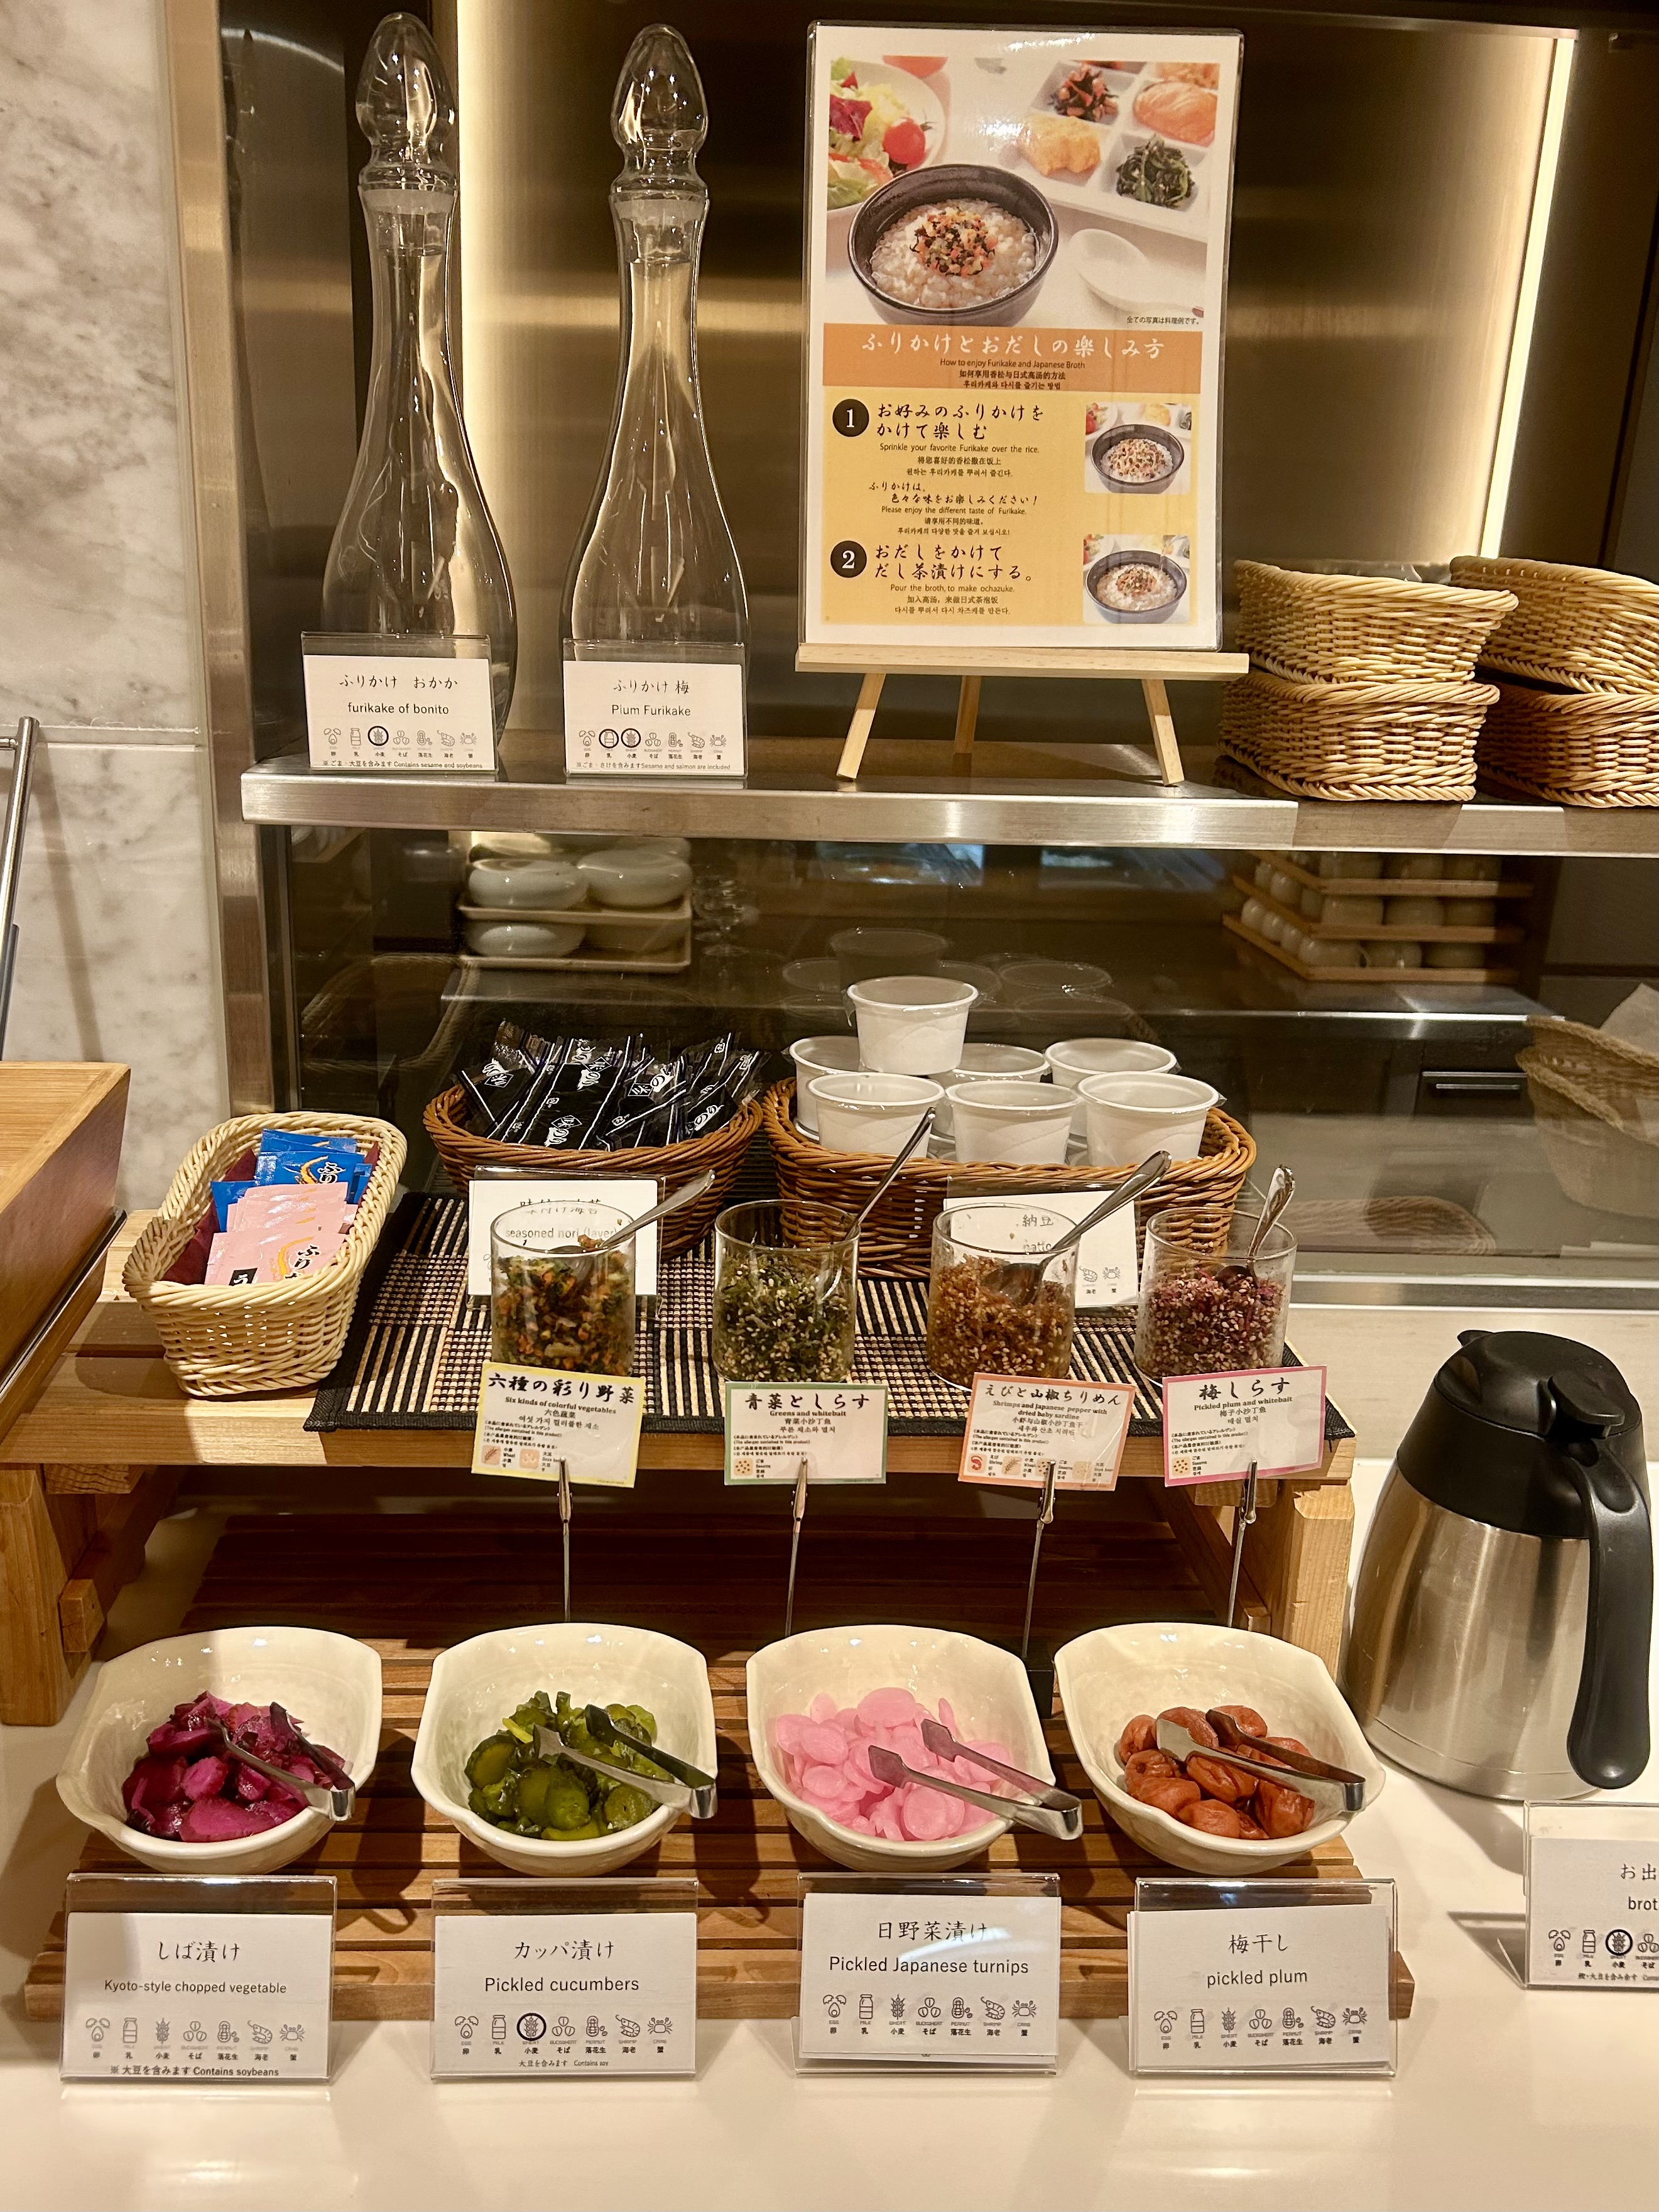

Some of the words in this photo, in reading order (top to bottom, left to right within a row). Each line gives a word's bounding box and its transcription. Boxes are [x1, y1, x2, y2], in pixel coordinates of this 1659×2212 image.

[1127, 316, 1200, 325] 全ての写真は料理例です。
[862, 332, 1165, 359] ふりかけとおだしの楽しみ方
[967, 359, 986, 368] enjoy
[1033, 360, 1064, 369] Japanese
[1066, 361, 1085, 369] Broth
[845, 408, 855, 428] 1
[878, 403, 1043, 421] お好みのふりかけを
[877, 422, 986, 440] かけて楽しむ
[880, 443, 908, 451] Sprinkle
[842, 550, 855, 569] 2
[875, 543, 1003, 561] おだしをかけて
[875, 563, 1031, 581] だし茶漬けにする。
[339, 674, 398, 689] ふりかけ
[413, 676, 458, 689] おかか
[613, 680, 668, 693] ふりかけ
[675, 680, 690, 694] 梅
[348, 702, 394, 713] furikake
[399, 704, 410, 713] of
[413, 704, 449, 714] bonito
[645, 706, 690, 716] Furikake
[1023, 1214, 1053, 1228] 納豆
[506, 1228, 553, 1238] seasoned
[488, 1373, 635, 1404] 六種の彩り野菜
[986, 1384, 1121, 1405] えびと山椒ちりめん
[1199, 1377, 1290, 1400] 梅しらす
[518, 1397, 538, 1405] kinds
[548, 1401, 576, 1410] colorful
[578, 1405, 616, 1414] vegetables
[745, 1393, 869, 1410] 青菜としらす
[878, 1921, 988, 1942] 日野菜漬け
[158, 1941, 240, 1963] しば漬け
[514, 1939, 614, 1961] カッパ漬け
[1229, 1934, 1288, 1954] 梅干し
[830, 1956, 887, 1971] Pickled
[893, 1958, 967, 1975] Japanese
[974, 1959, 1028, 1975] turnips
[104, 1980, 171, 1993] Kyoto-style
[175, 1981, 226, 1994] chopped
[229, 1983, 287, 1995] vegetable
[486, 1978, 543, 1991] Pickled
[550, 1977, 639, 1991] cucumbers
[1207, 1970, 1263, 1988] pickled
[1269, 1969, 1308, 1986] plum
[193, 2066, 234, 2076] Contains
[237, 2068, 279, 2077] soybeans
